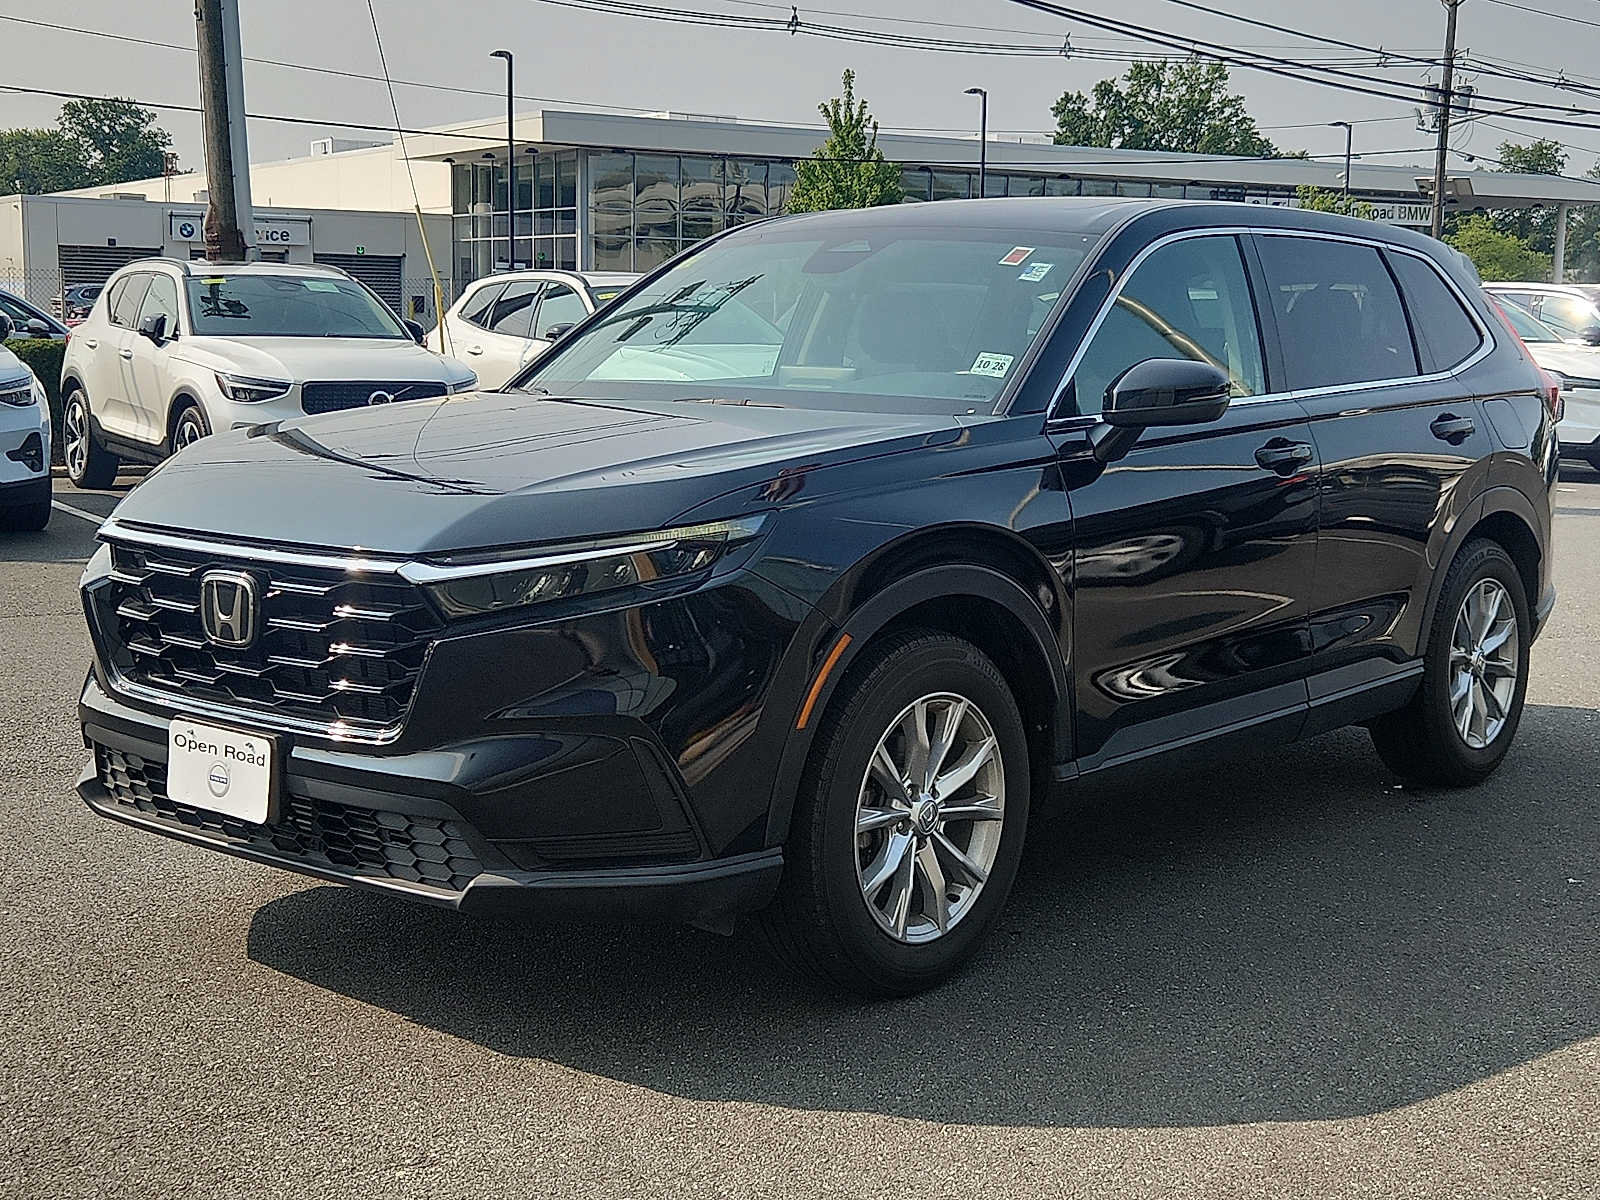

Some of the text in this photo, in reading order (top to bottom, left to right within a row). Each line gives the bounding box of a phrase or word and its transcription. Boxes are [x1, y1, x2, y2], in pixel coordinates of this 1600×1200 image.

[1398, 206, 1431, 221] BMW
[976, 359, 991, 369] 10
[174, 734, 266, 767] Open Road
